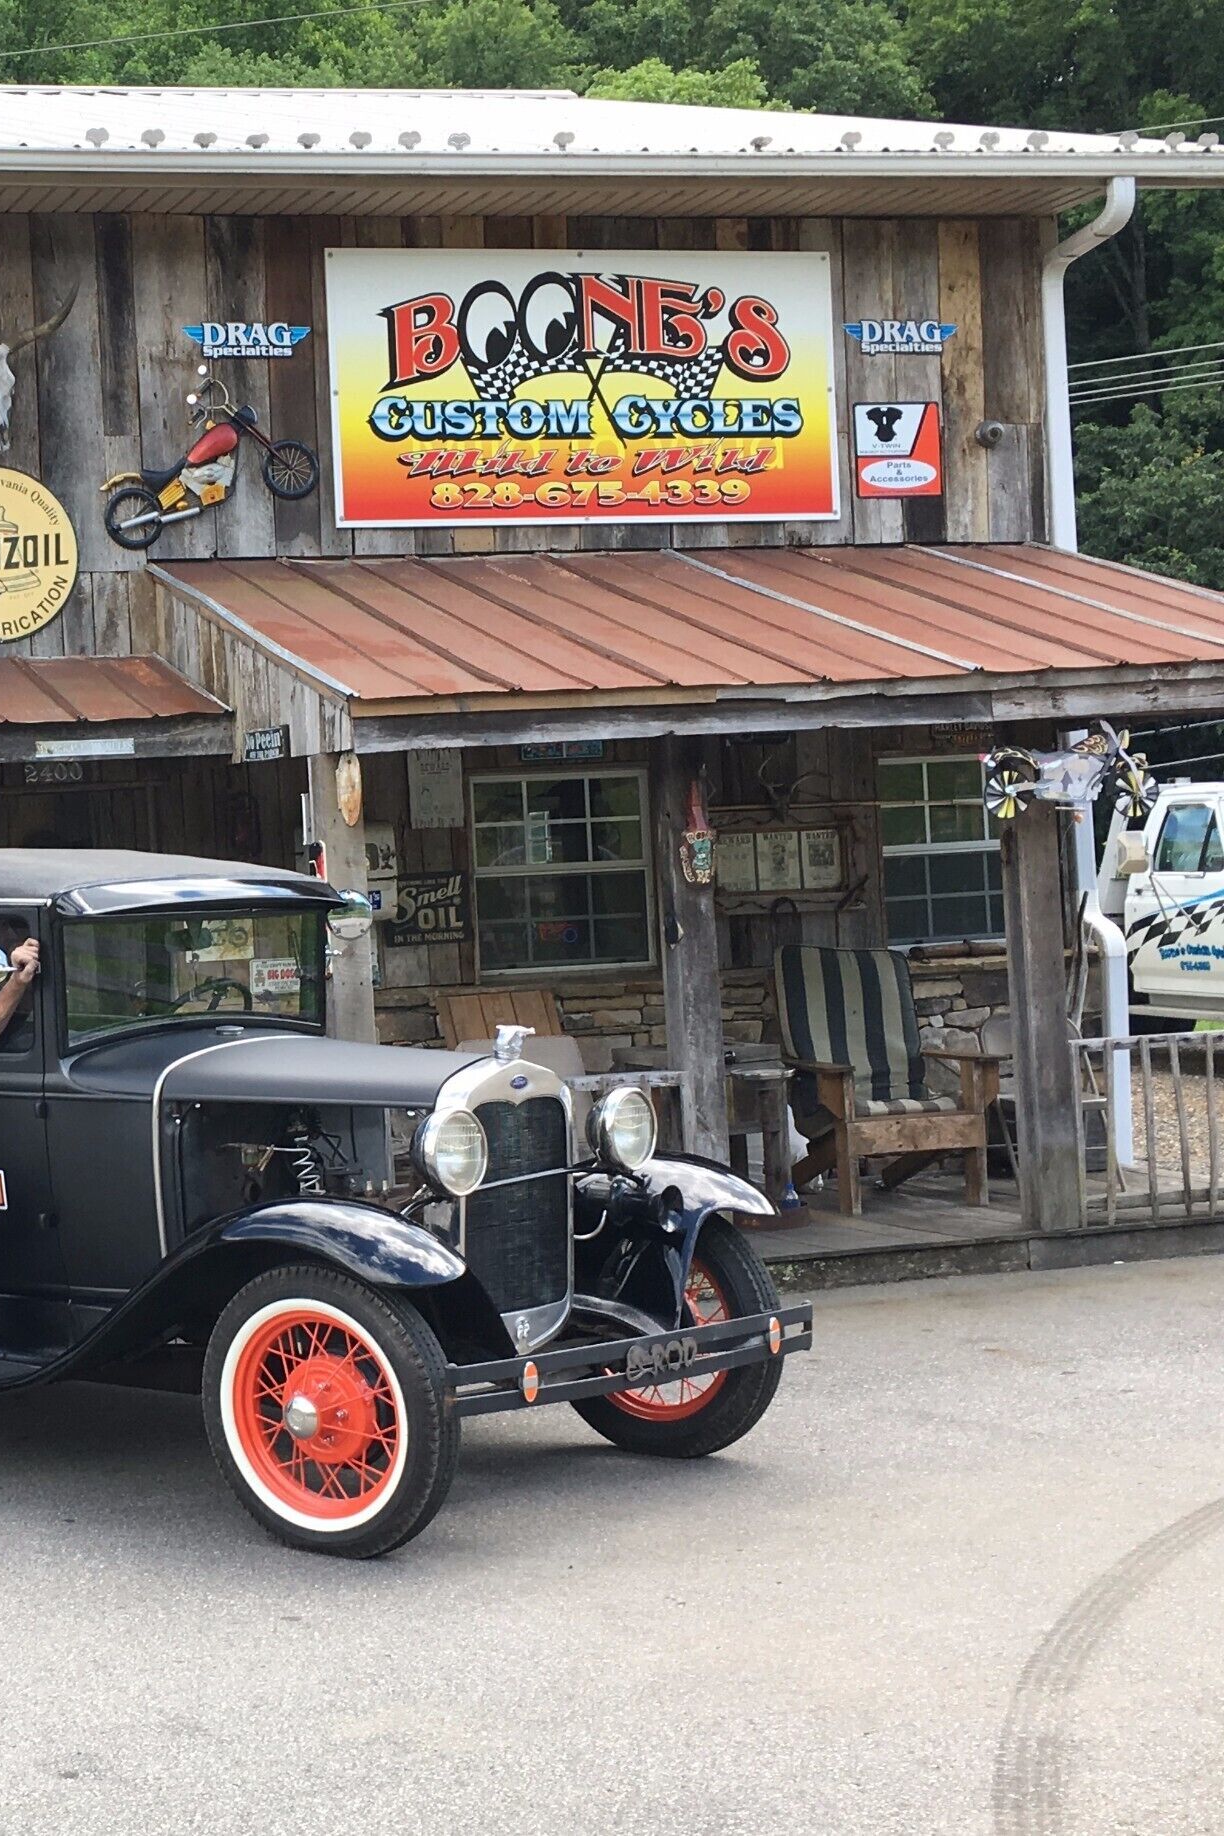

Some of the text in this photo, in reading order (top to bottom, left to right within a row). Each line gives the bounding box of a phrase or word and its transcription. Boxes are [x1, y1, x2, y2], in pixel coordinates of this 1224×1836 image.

[202, 322, 292, 346] DRAG
[377, 271, 792, 392] BOONE'S
[860, 321, 942, 342] DRAG
[203, 346, 293, 359] Specialties
[861, 342, 943, 354] Specialties
[368, 395, 804, 442] CUSTOM CYCLES
[399, 439, 778, 480] Mild to Wild
[870, 475, 928, 483] Accessories
[430, 480, 752, 510] 828-675-4339
[30, 490, 60, 526] Quality
[25, 763, 83, 783] 2400
[389, 874, 463, 924] Smell
[417, 906, 464, 929] OIL
[406, 934, 422, 942] THE
[424, 931, 465, 941] MORNING
